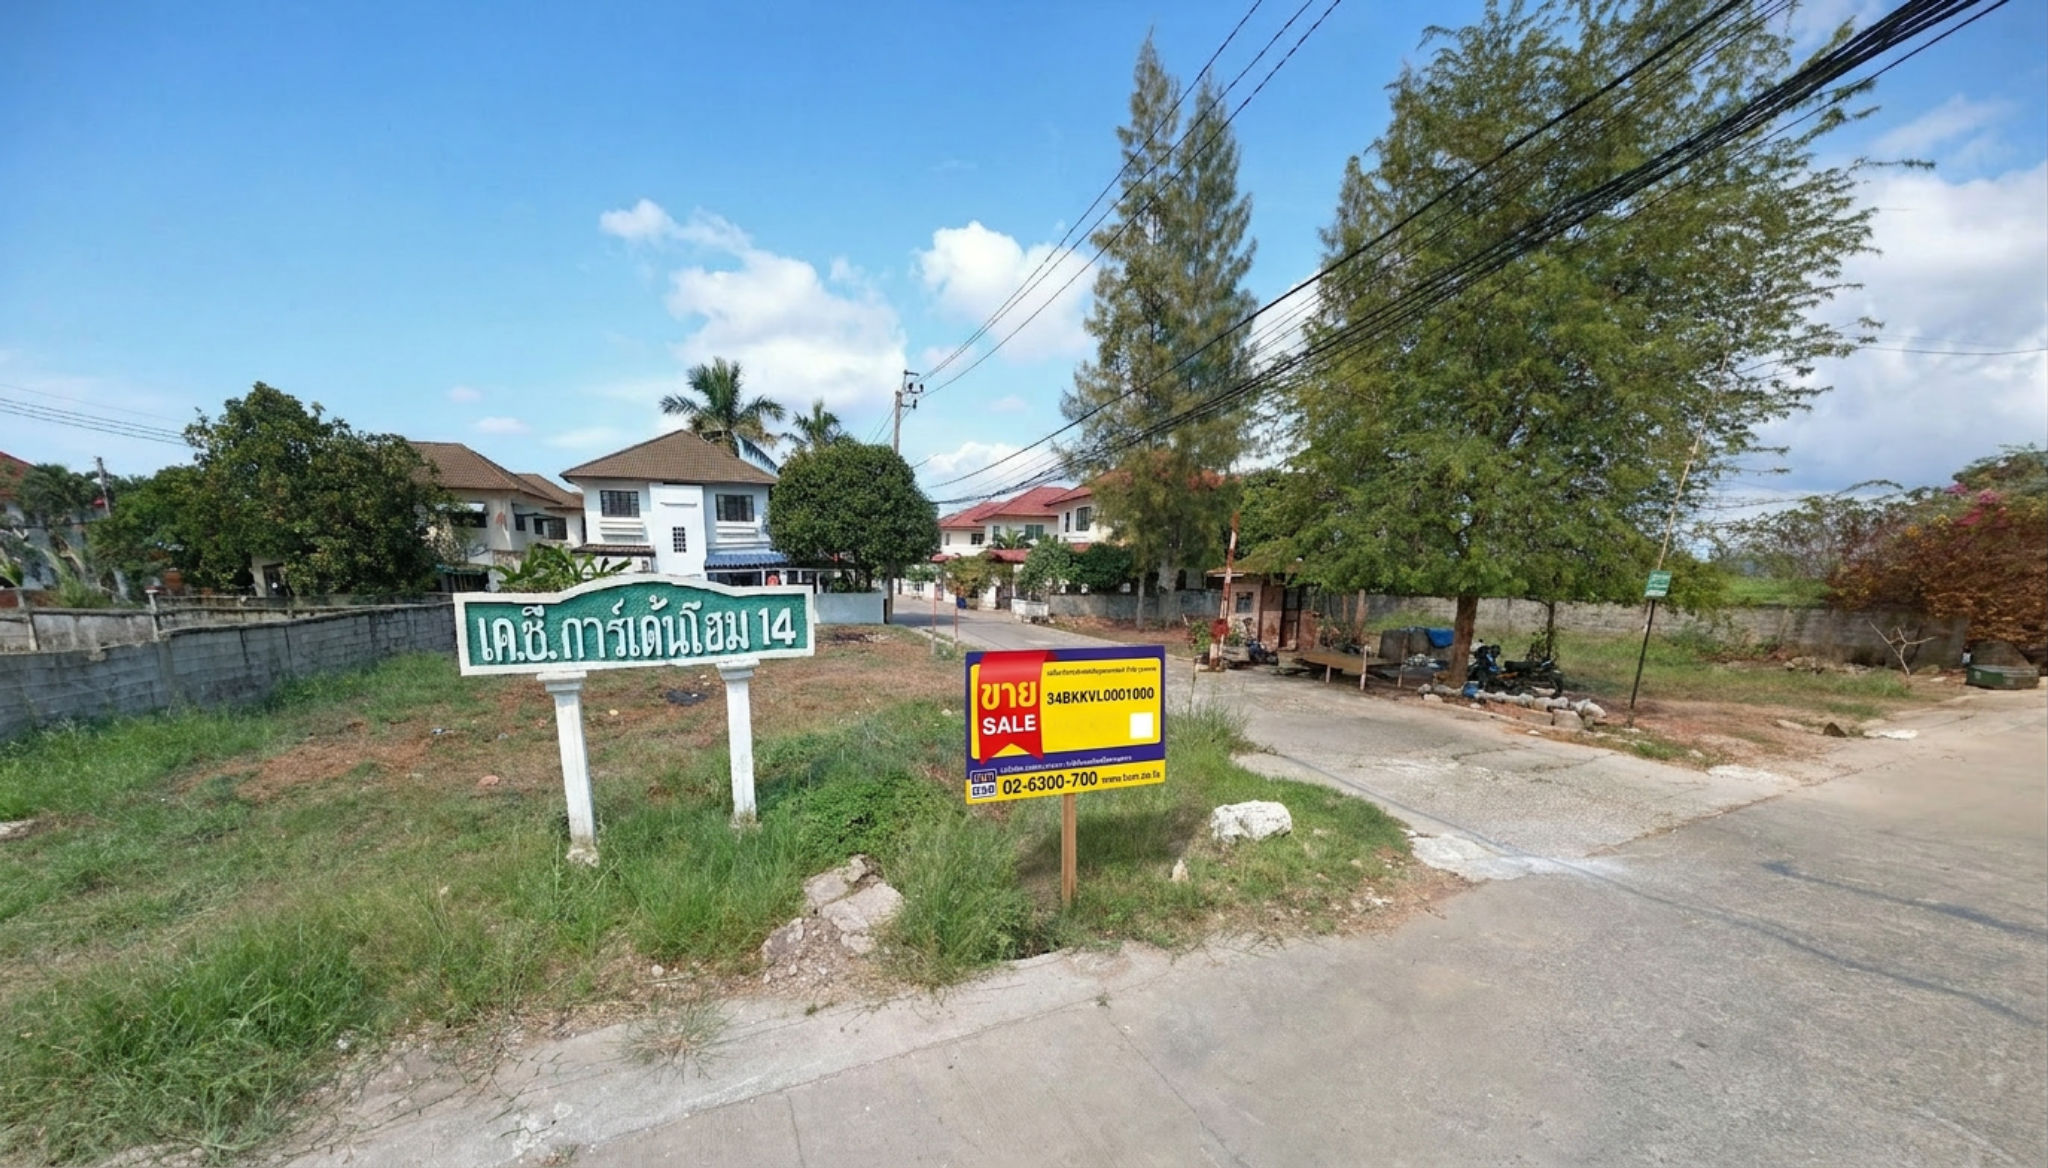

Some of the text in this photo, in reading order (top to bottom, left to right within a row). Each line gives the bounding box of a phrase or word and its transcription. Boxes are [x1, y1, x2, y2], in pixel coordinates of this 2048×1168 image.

[758, 607, 797, 646] 14
[981, 681, 1037, 710] ขาย
[1046, 687, 1155, 705] 34BKKVL0001000
[982, 714, 1036, 736] SALE
[1002, 771, 1098, 795] 02-6300-700
